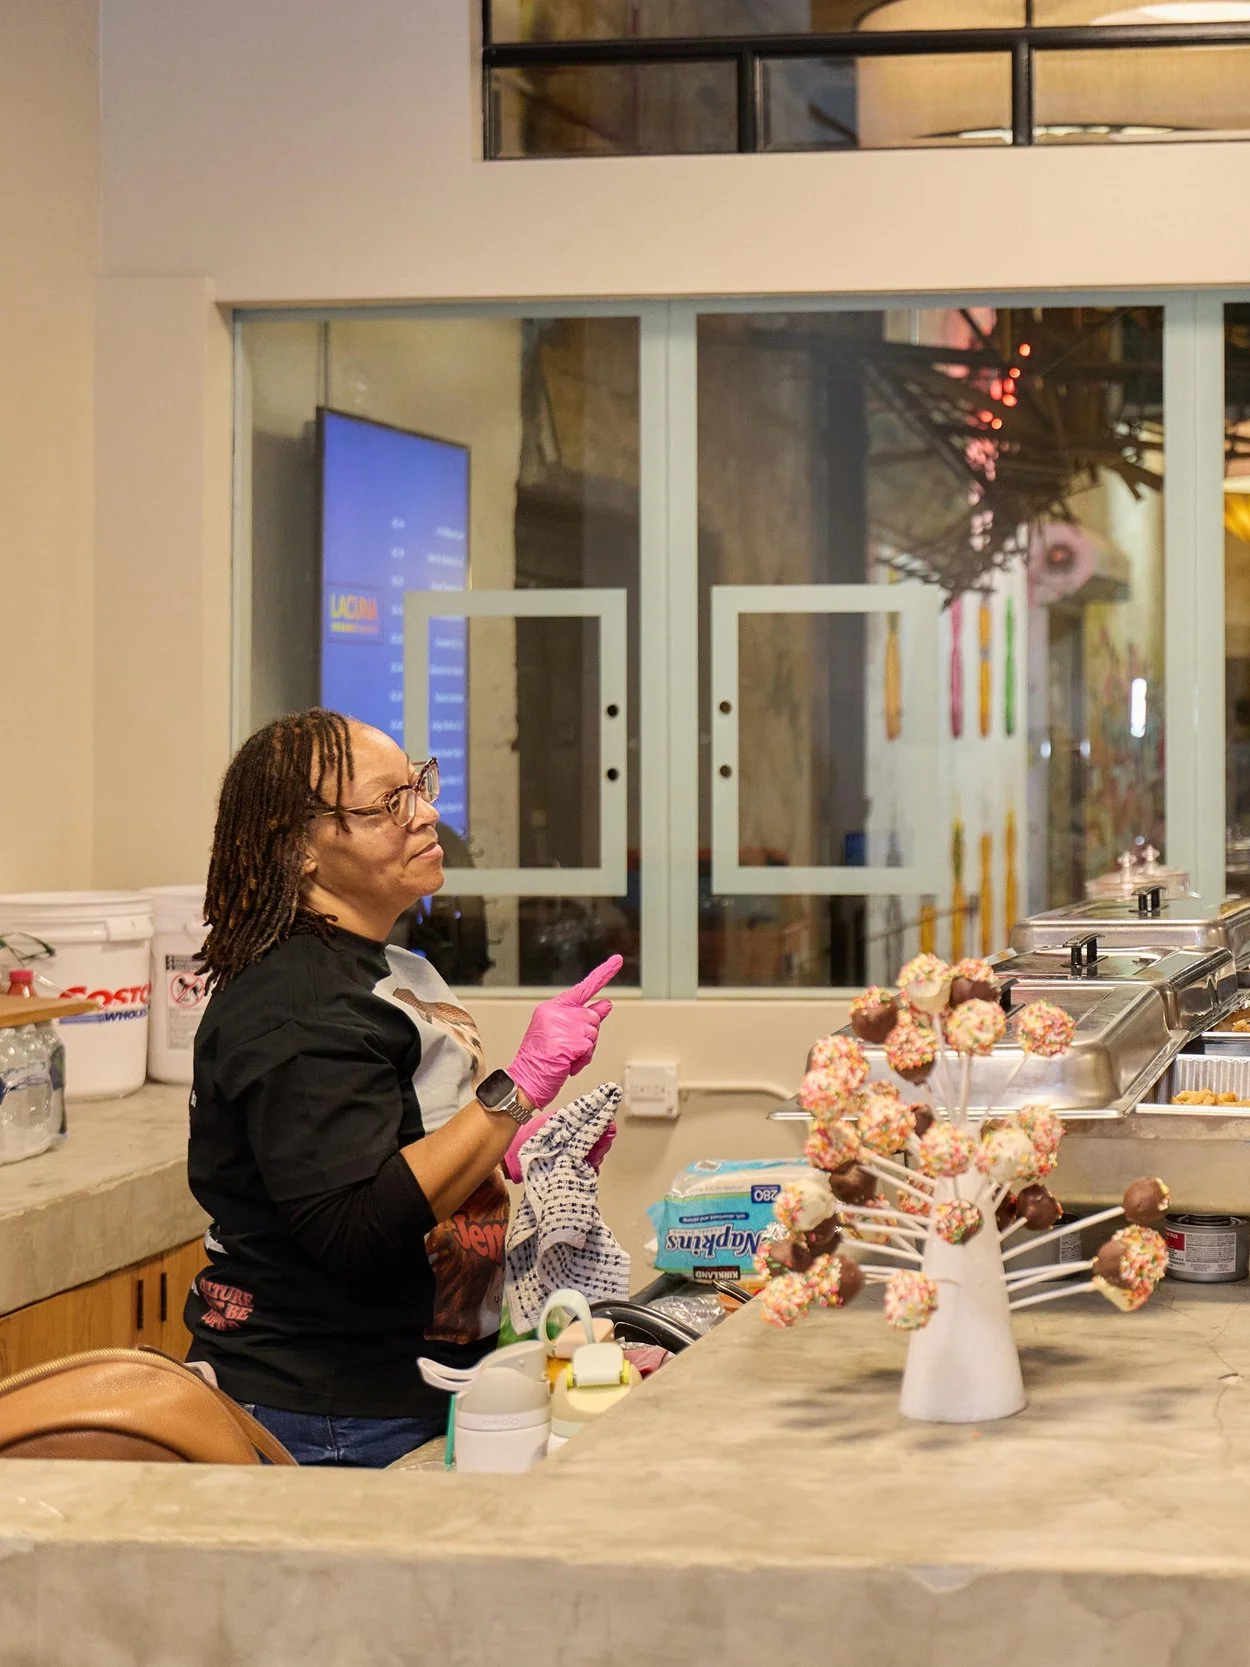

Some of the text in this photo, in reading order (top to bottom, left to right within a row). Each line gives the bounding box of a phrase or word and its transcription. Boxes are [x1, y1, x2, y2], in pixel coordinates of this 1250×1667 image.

[754, 1189, 778, 1202] 280
[665, 1225, 763, 1256] Napkins
[695, 1270, 739, 1280] KIRKLAND
[225, 1303, 254, 1321] BE
